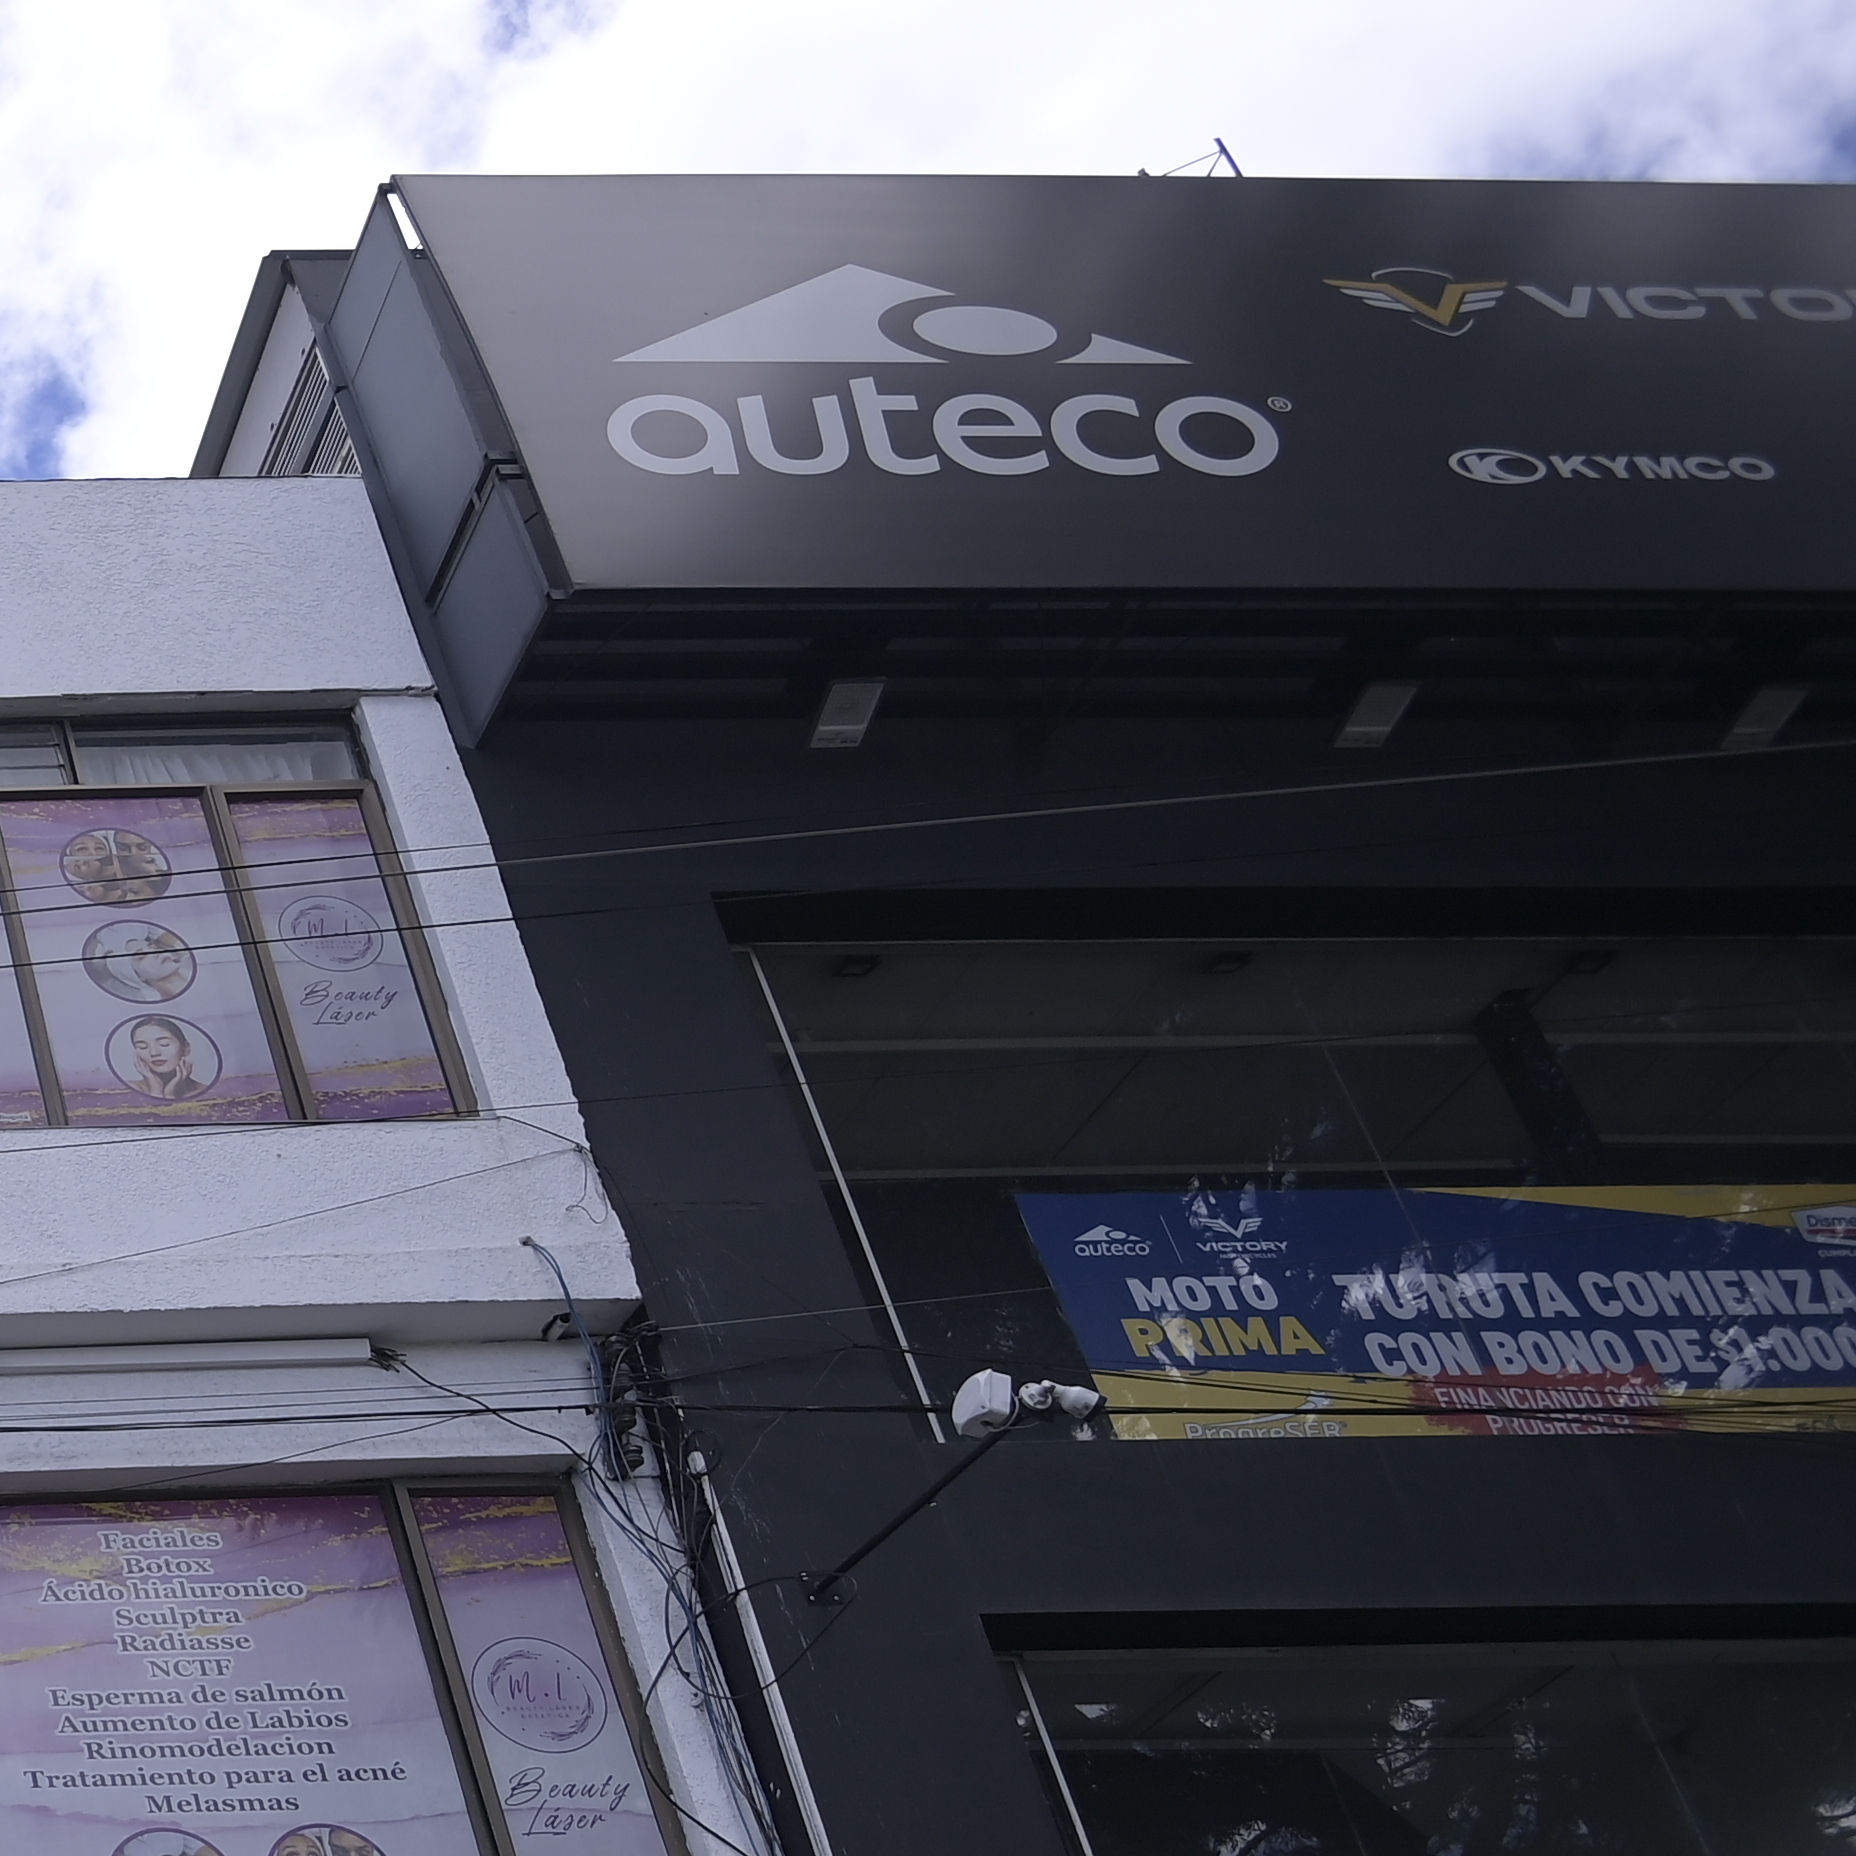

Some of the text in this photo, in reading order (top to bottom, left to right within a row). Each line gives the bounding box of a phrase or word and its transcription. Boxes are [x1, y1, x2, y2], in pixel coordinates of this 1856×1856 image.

[606, 377, 1280, 477] auteco
[1550, 455, 1775, 480] KYMCO
[1074, 1241, 1149, 1256] auteco
[1196, 1241, 1287, 1251] VICTORY
[1125, 1276, 1278, 1311] MOTO
[1121, 1317, 1326, 1357] PRIMA
[1364, 1328, 1717, 1376] CON BONO DE
[100, 1531, 220, 1550] Faciales
[124, 1556, 210, 1574] Botox
[42, 1578, 303, 1602] Ácido hialuronico
[115, 1607, 242, 1629] Sculptra
[119, 1633, 251, 1652] Radiasse
[149, 1659, 230, 1678] NCTF
[50, 1682, 344, 1710] Esperma de salmón
[59, 1709, 349, 1733] Aumento de Labios
[85, 1737, 334, 1760] Rinomodelacion
[24, 1761, 406, 1789] Tratamiento para el acné
[506, 1767, 630, 1810] Beauty
[147, 1793, 299, 1814] Melasmas
[523, 1800, 606, 1836] Láser
